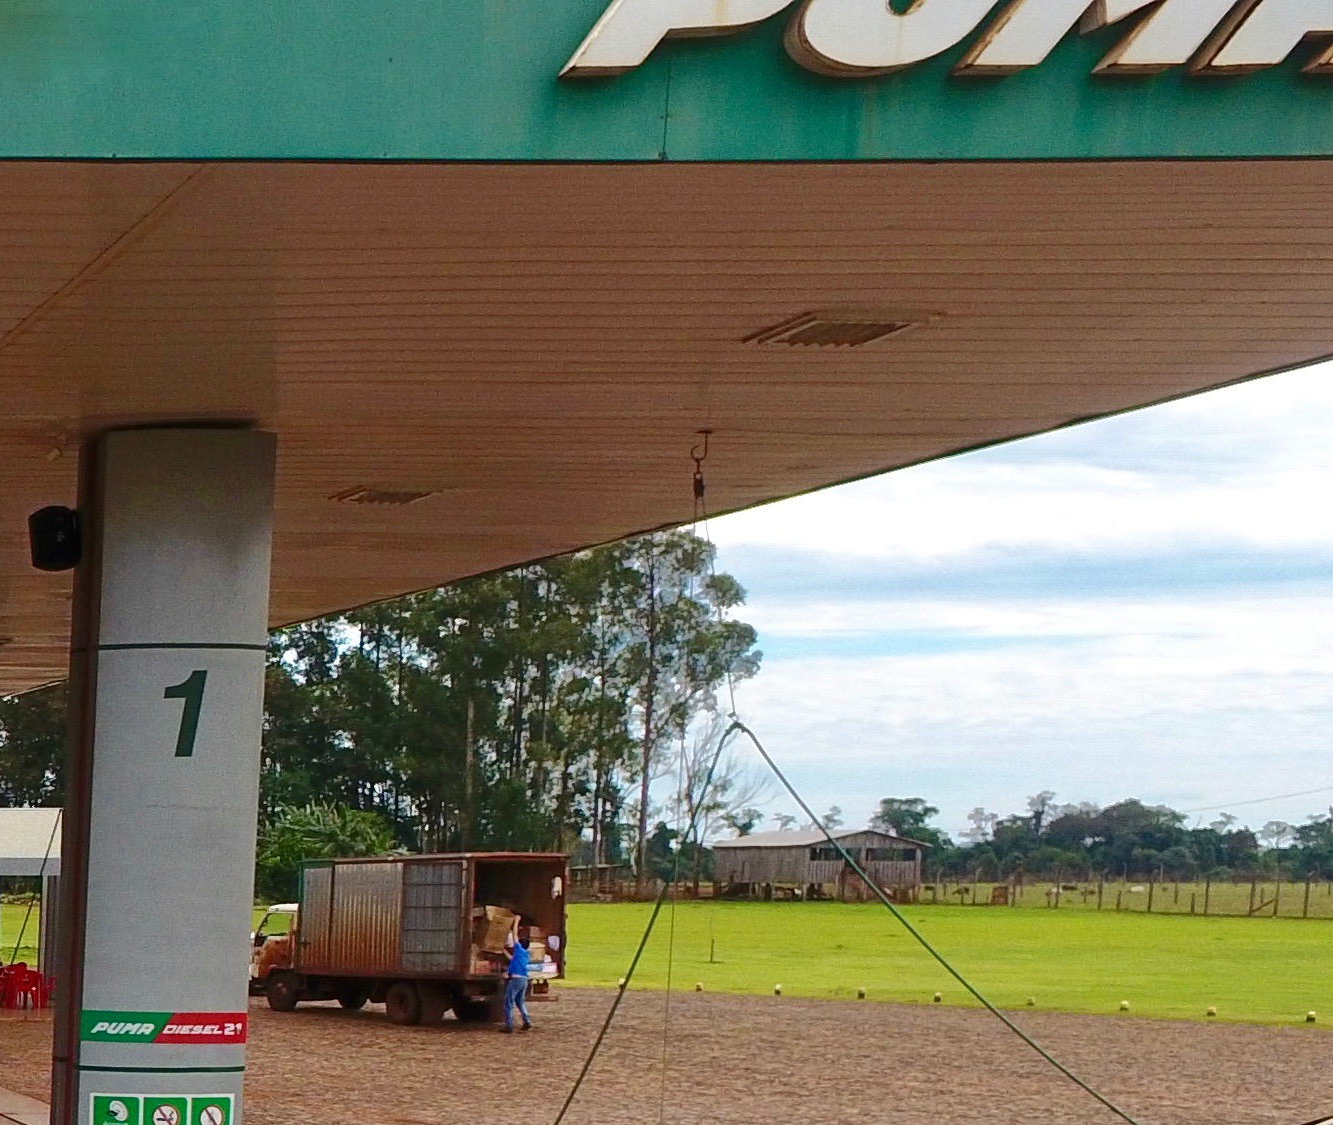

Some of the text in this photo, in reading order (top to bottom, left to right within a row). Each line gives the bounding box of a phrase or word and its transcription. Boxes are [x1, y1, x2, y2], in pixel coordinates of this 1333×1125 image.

[163, 669, 208, 758] 1
[90, 1021, 156, 1036] PUMA
[161, 1024, 223, 1035] DIESEL
